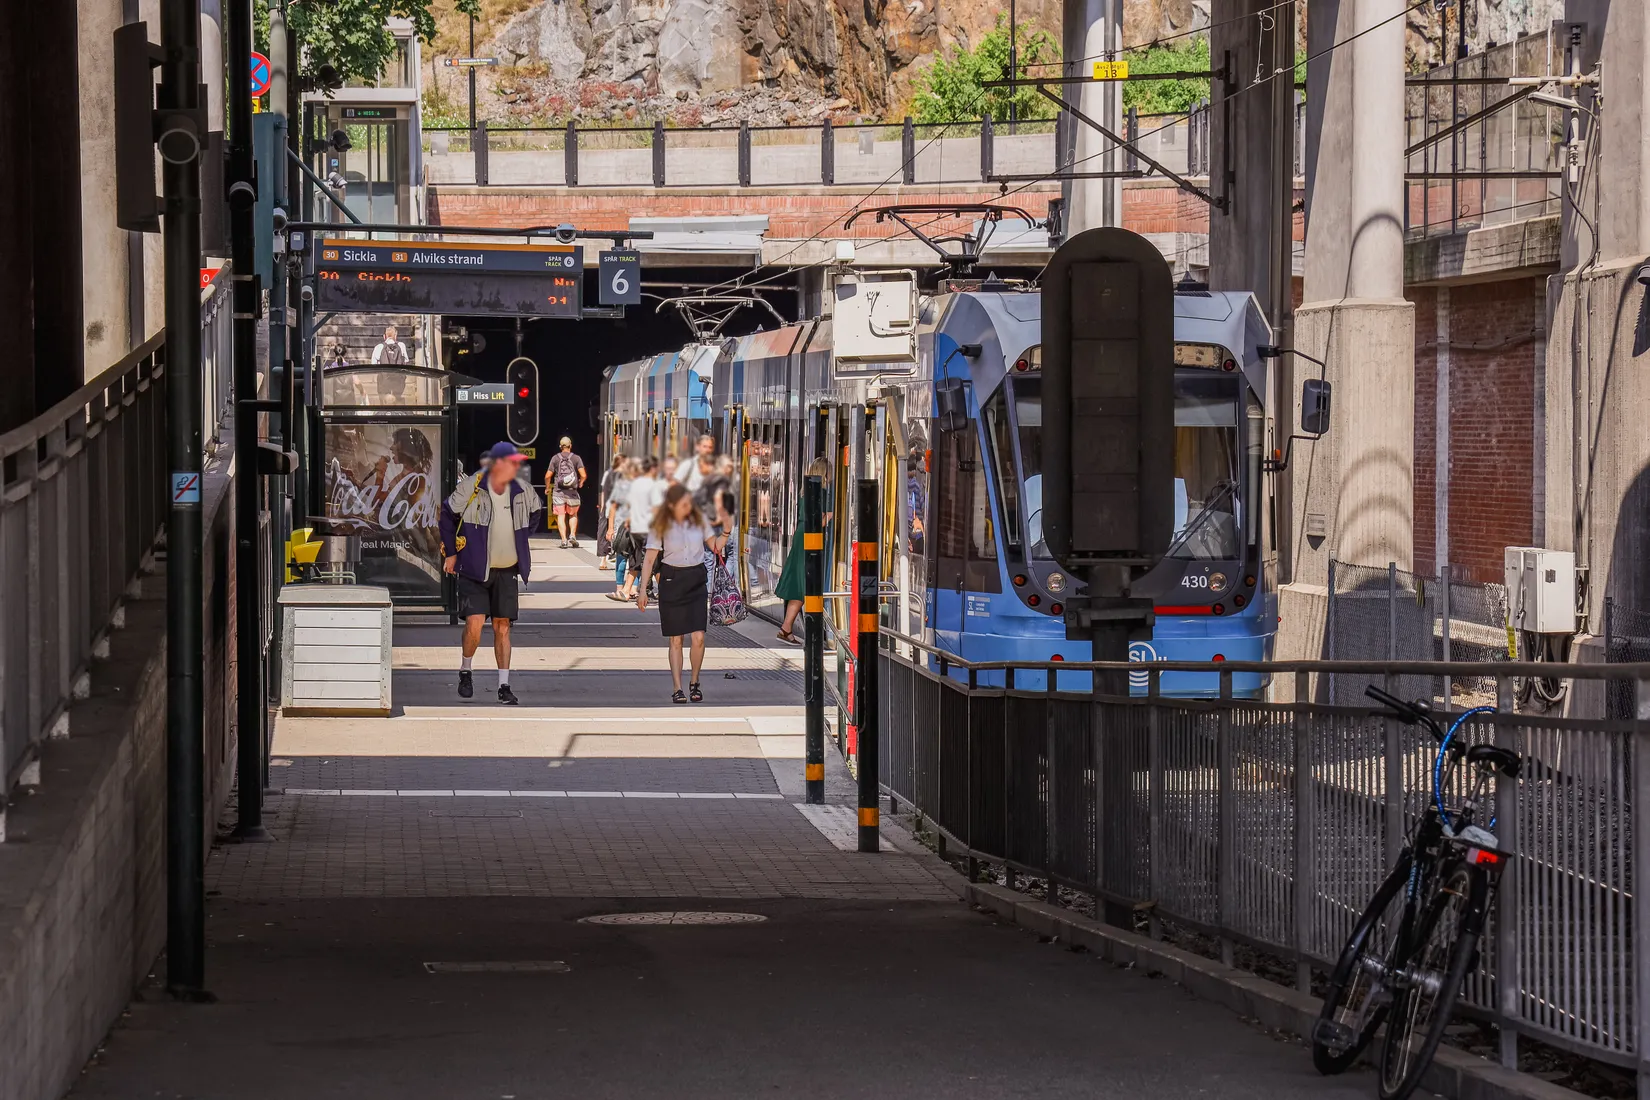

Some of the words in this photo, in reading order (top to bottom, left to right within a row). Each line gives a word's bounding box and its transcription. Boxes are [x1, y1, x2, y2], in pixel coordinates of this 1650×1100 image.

[326, 251, 336, 259] 30
[343, 250, 377, 262] Sickla
[395, 253, 404, 261] 31
[412, 252, 446, 264] Alviks
[448, 254, 484, 265] strand
[612, 269, 629, 295] 6
[473, 391, 489, 400] Hiss
[491, 391, 505, 400] Lift
[380, 540, 411, 550] Magic
[1181, 575, 1208, 588] 430
